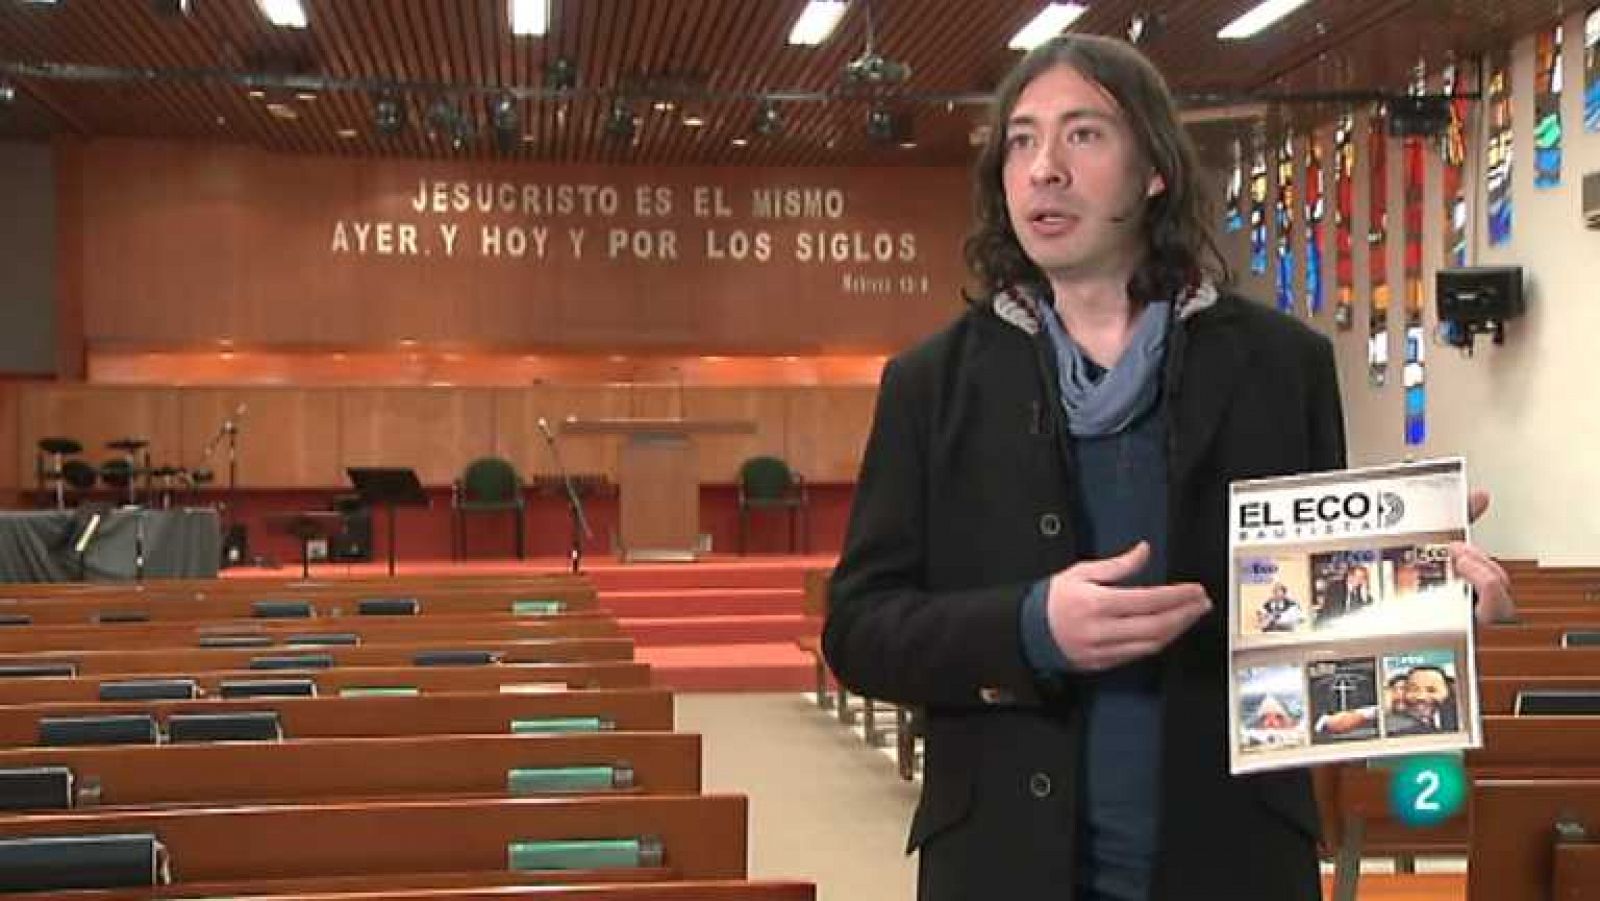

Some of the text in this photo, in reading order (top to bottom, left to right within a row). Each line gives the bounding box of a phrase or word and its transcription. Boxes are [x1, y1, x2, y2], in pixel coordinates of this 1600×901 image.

[411, 178, 844, 218] JESUCRISTO ES EL MISMO
[440, 222, 457, 256] Y
[482, 225, 547, 257] HOY
[570, 229, 585, 259] Y
[609, 230, 677, 260] POR
[707, 231, 770, 261] LOS
[796, 231, 916, 264] SIGLOS
[1239, 492, 1370, 528] EL ECO
